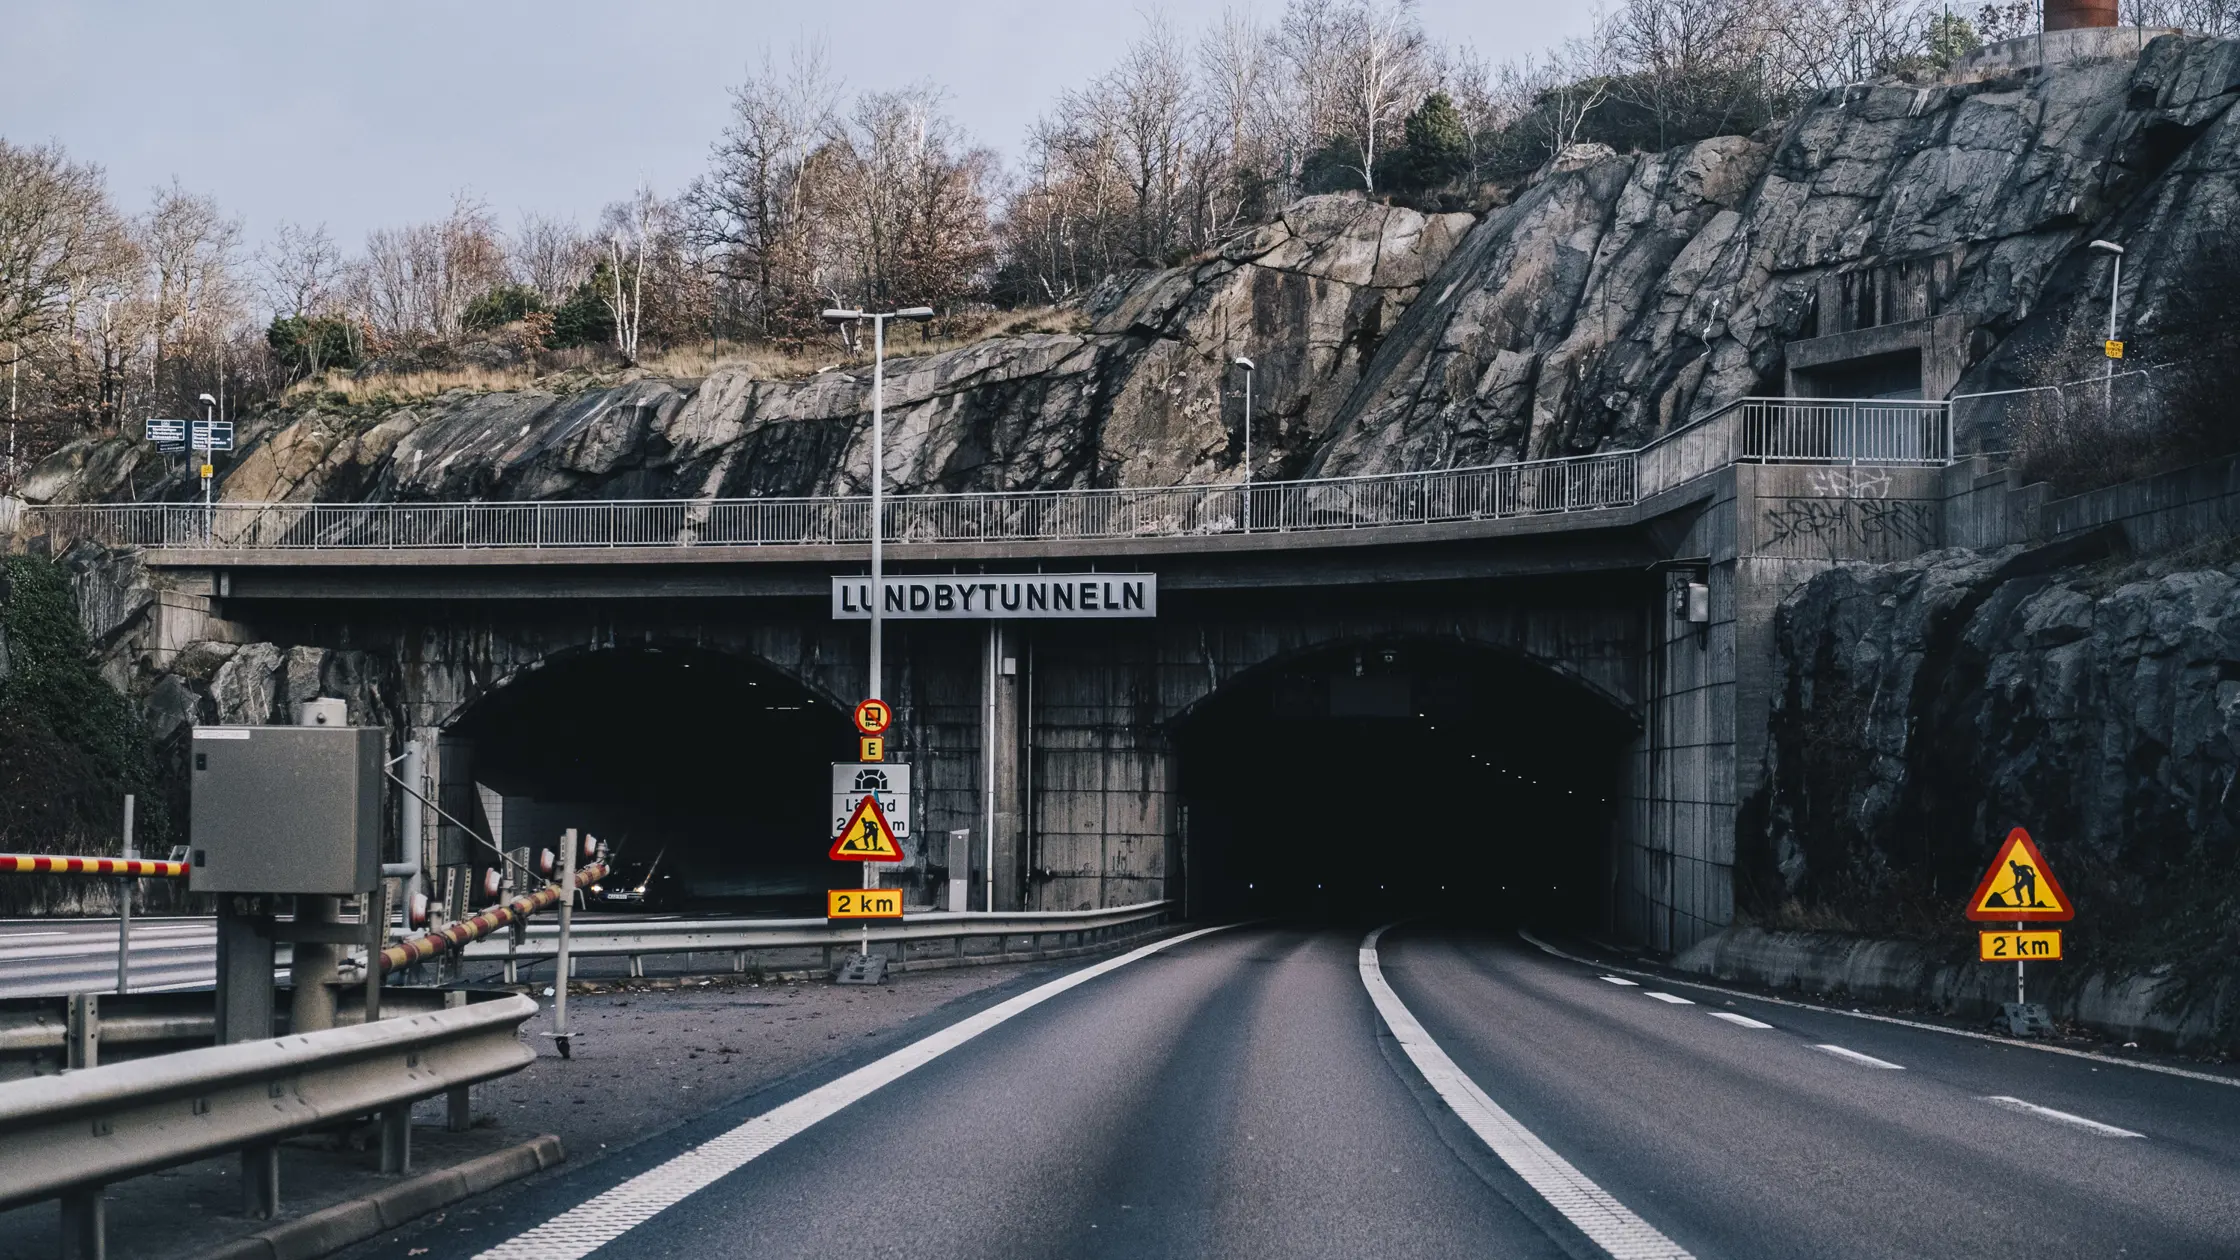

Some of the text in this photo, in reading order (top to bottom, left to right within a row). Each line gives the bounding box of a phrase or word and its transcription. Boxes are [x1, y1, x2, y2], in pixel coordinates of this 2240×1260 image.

[841, 581, 1146, 613] LUNDBYTUNNELN
[868, 742, 876, 756] E
[893, 821, 905, 831] m
[837, 895, 893, 913] 2 km
[1993, 935, 2049, 956] 2 km
